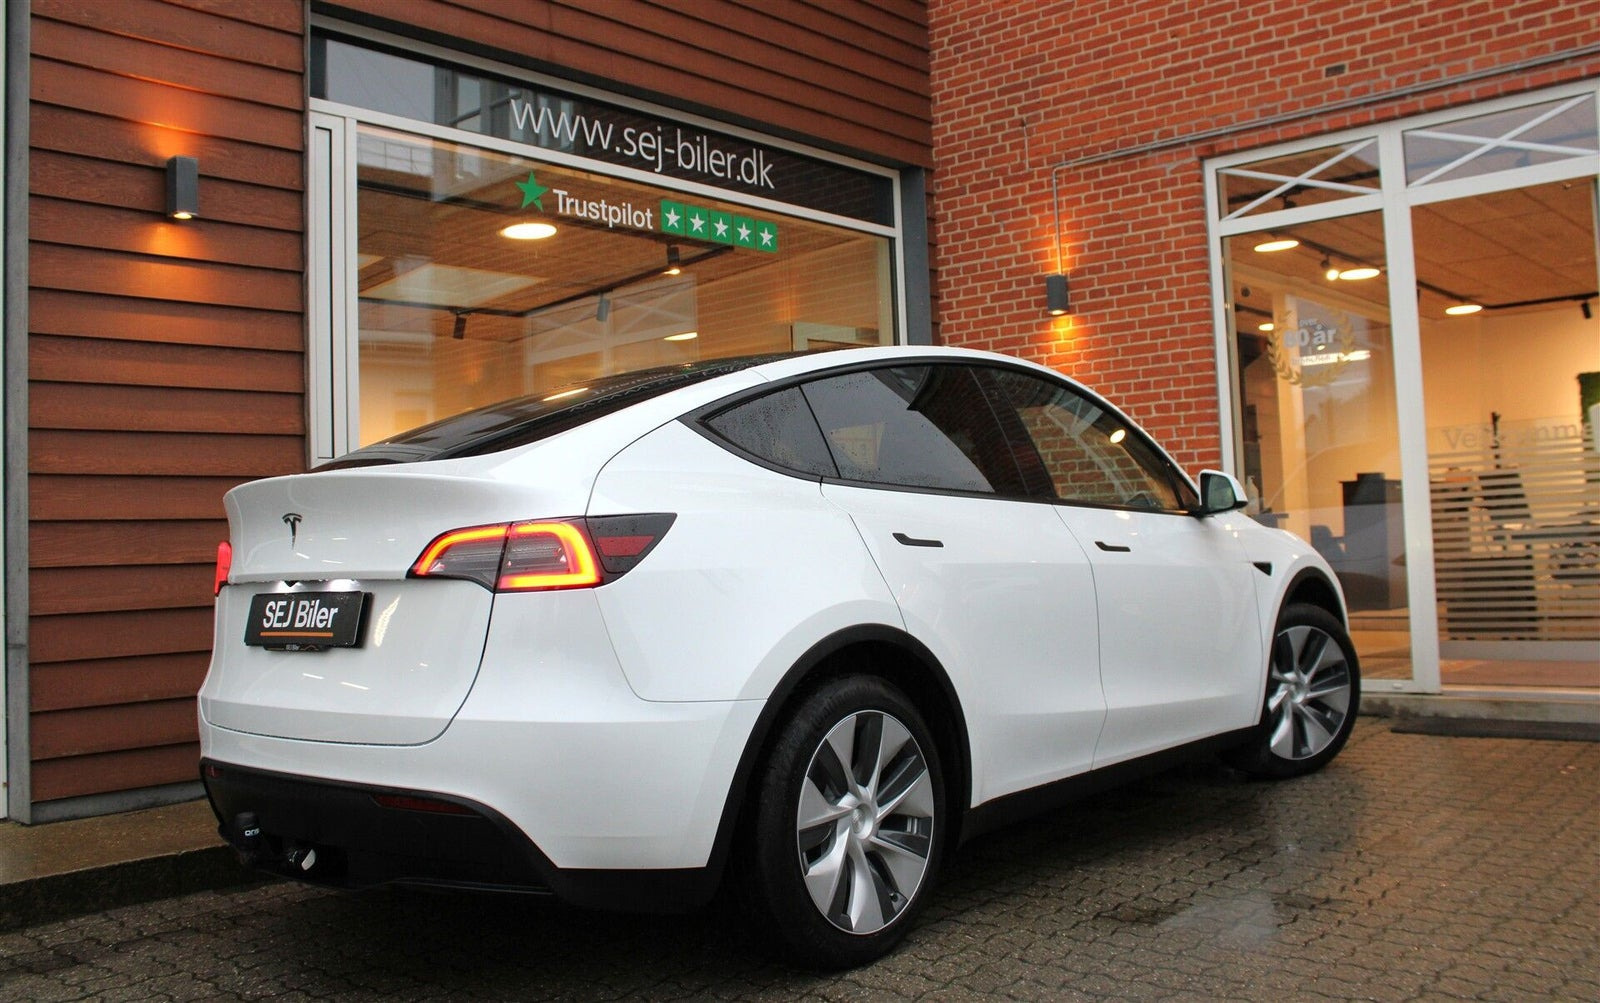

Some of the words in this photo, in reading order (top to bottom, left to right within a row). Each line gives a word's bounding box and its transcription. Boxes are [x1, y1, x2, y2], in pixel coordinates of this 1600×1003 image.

[510, 98, 776, 190] www.sej-biler.dk
[552, 188, 654, 231] Trustpilot
[1312, 323, 1337, 345] år
[262, 600, 295, 629] SEJ
[294, 599, 339, 629] Biler
